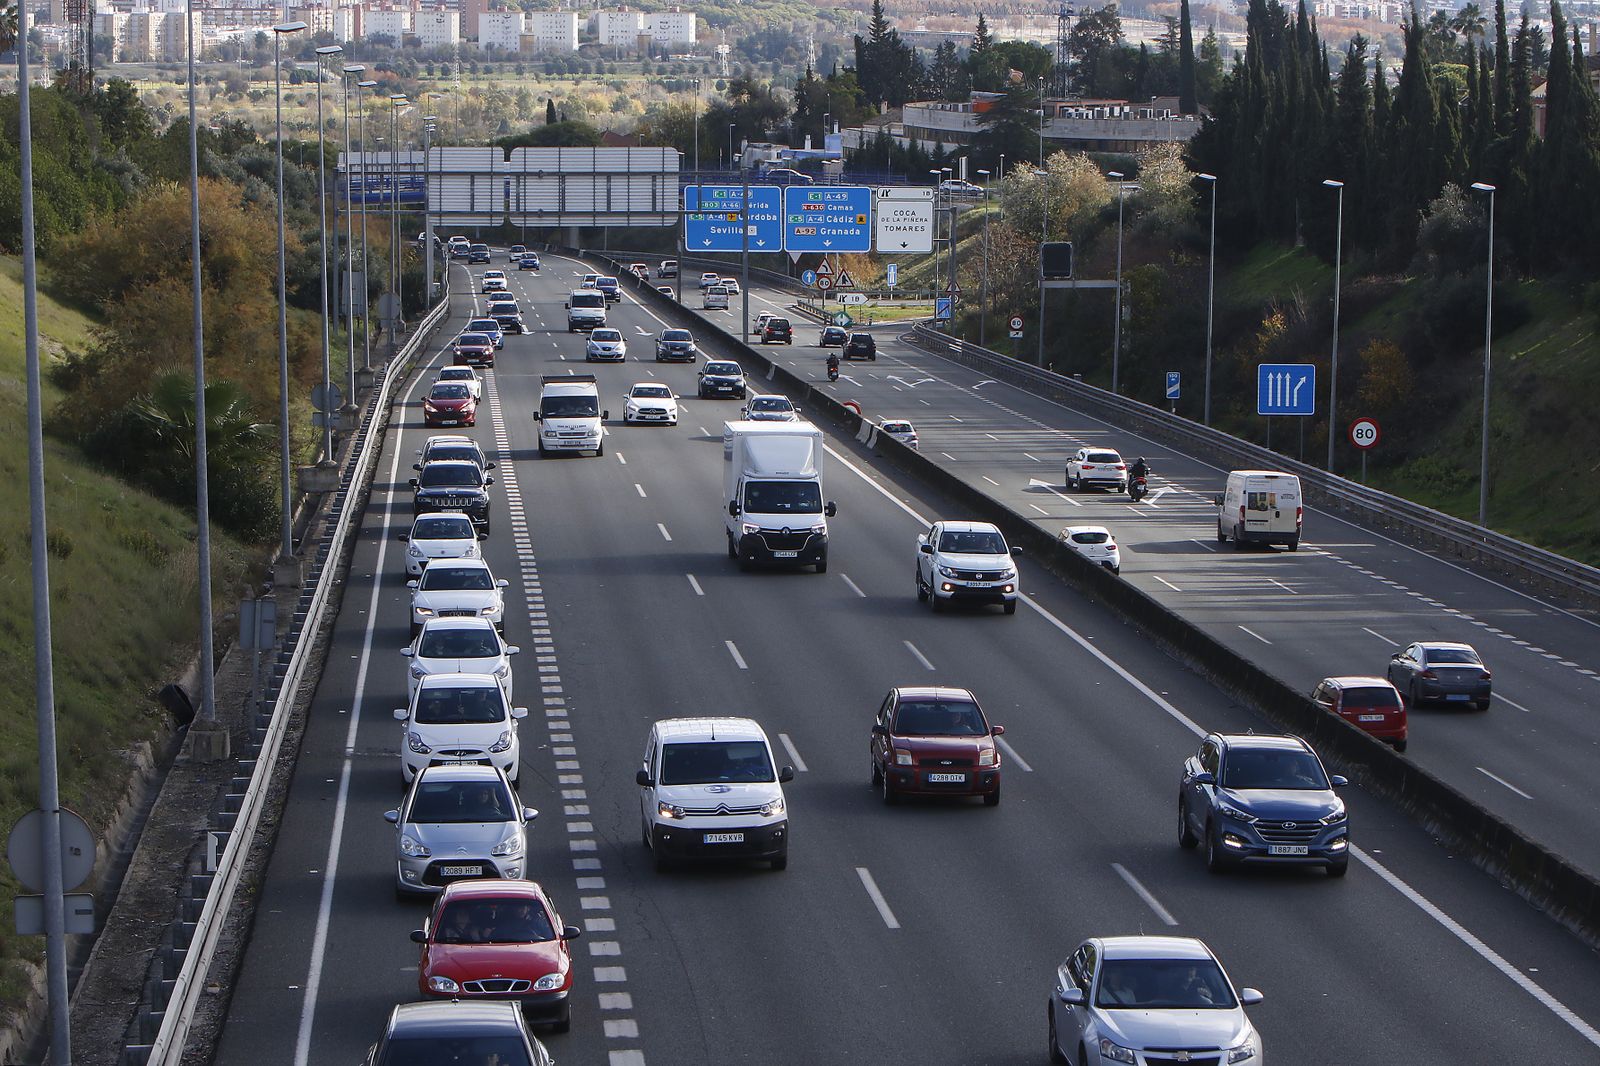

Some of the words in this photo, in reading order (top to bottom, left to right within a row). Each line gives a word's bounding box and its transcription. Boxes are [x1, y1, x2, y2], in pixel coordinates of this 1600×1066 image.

[743, 201, 769, 209] érida
[826, 215, 854, 223] Cádiz
[710, 226, 744, 234] Sevilla
[1355, 428, 1374, 439] 80
[708, 834, 727, 842] 7145
[445, 867, 463, 875] 2089
